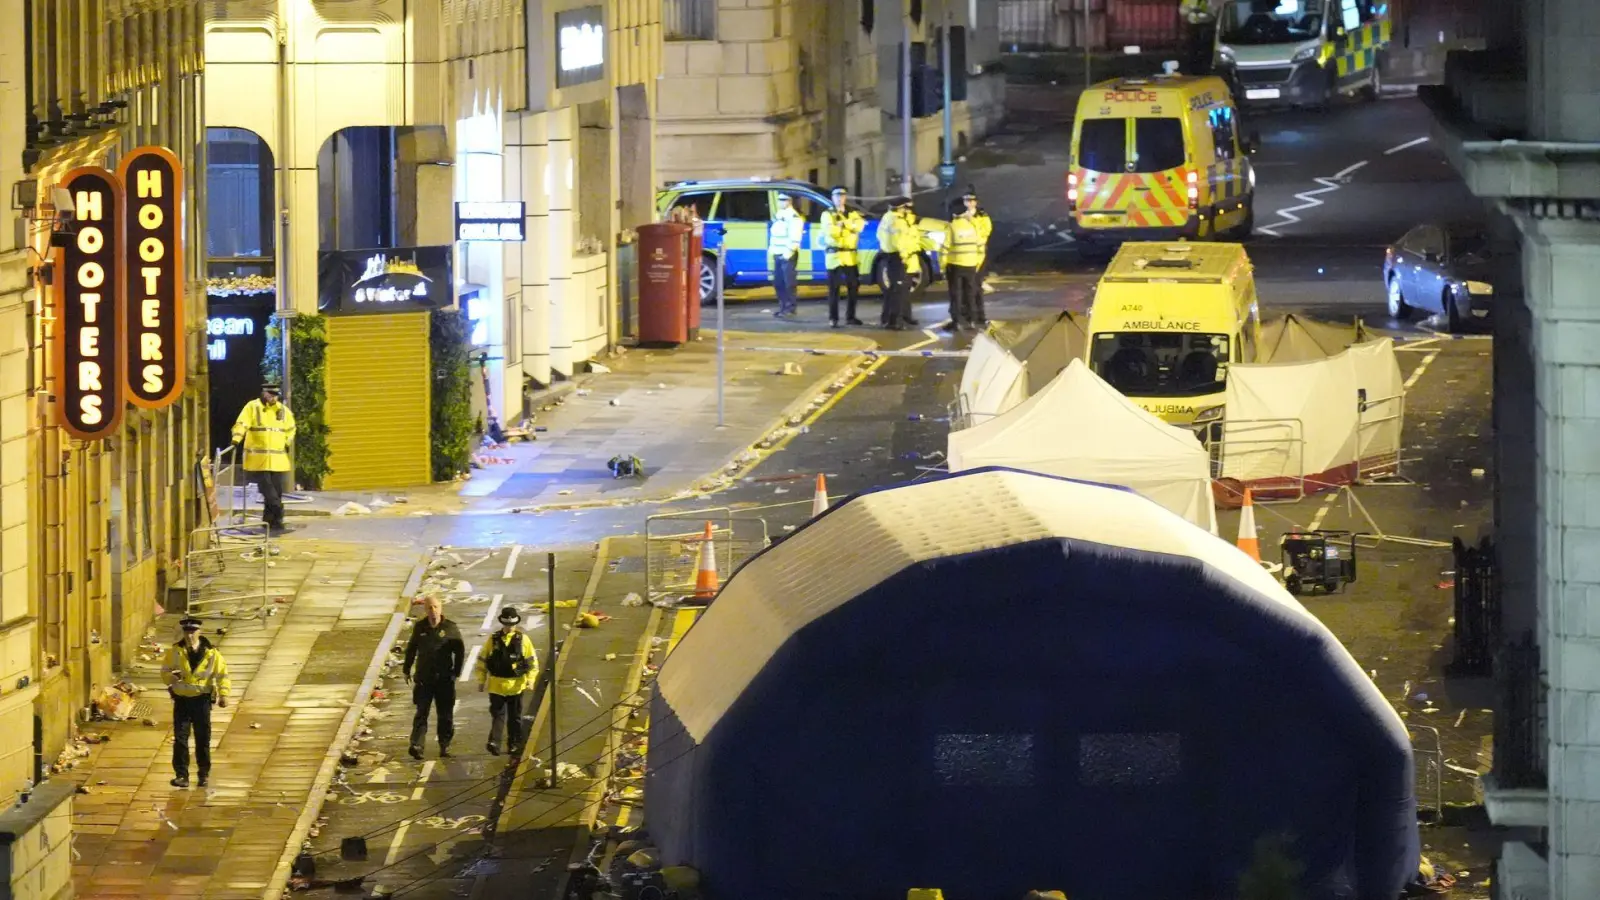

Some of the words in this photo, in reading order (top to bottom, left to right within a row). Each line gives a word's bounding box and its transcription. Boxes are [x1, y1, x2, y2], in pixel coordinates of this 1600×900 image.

[1104, 91, 1157, 102] POLICE
[137, 169, 165, 394] HOOTERS
[75, 190, 104, 425] HOOTERS
[1121, 304, 1143, 312] A740
[1122, 320, 1201, 331] AMBULANCE
